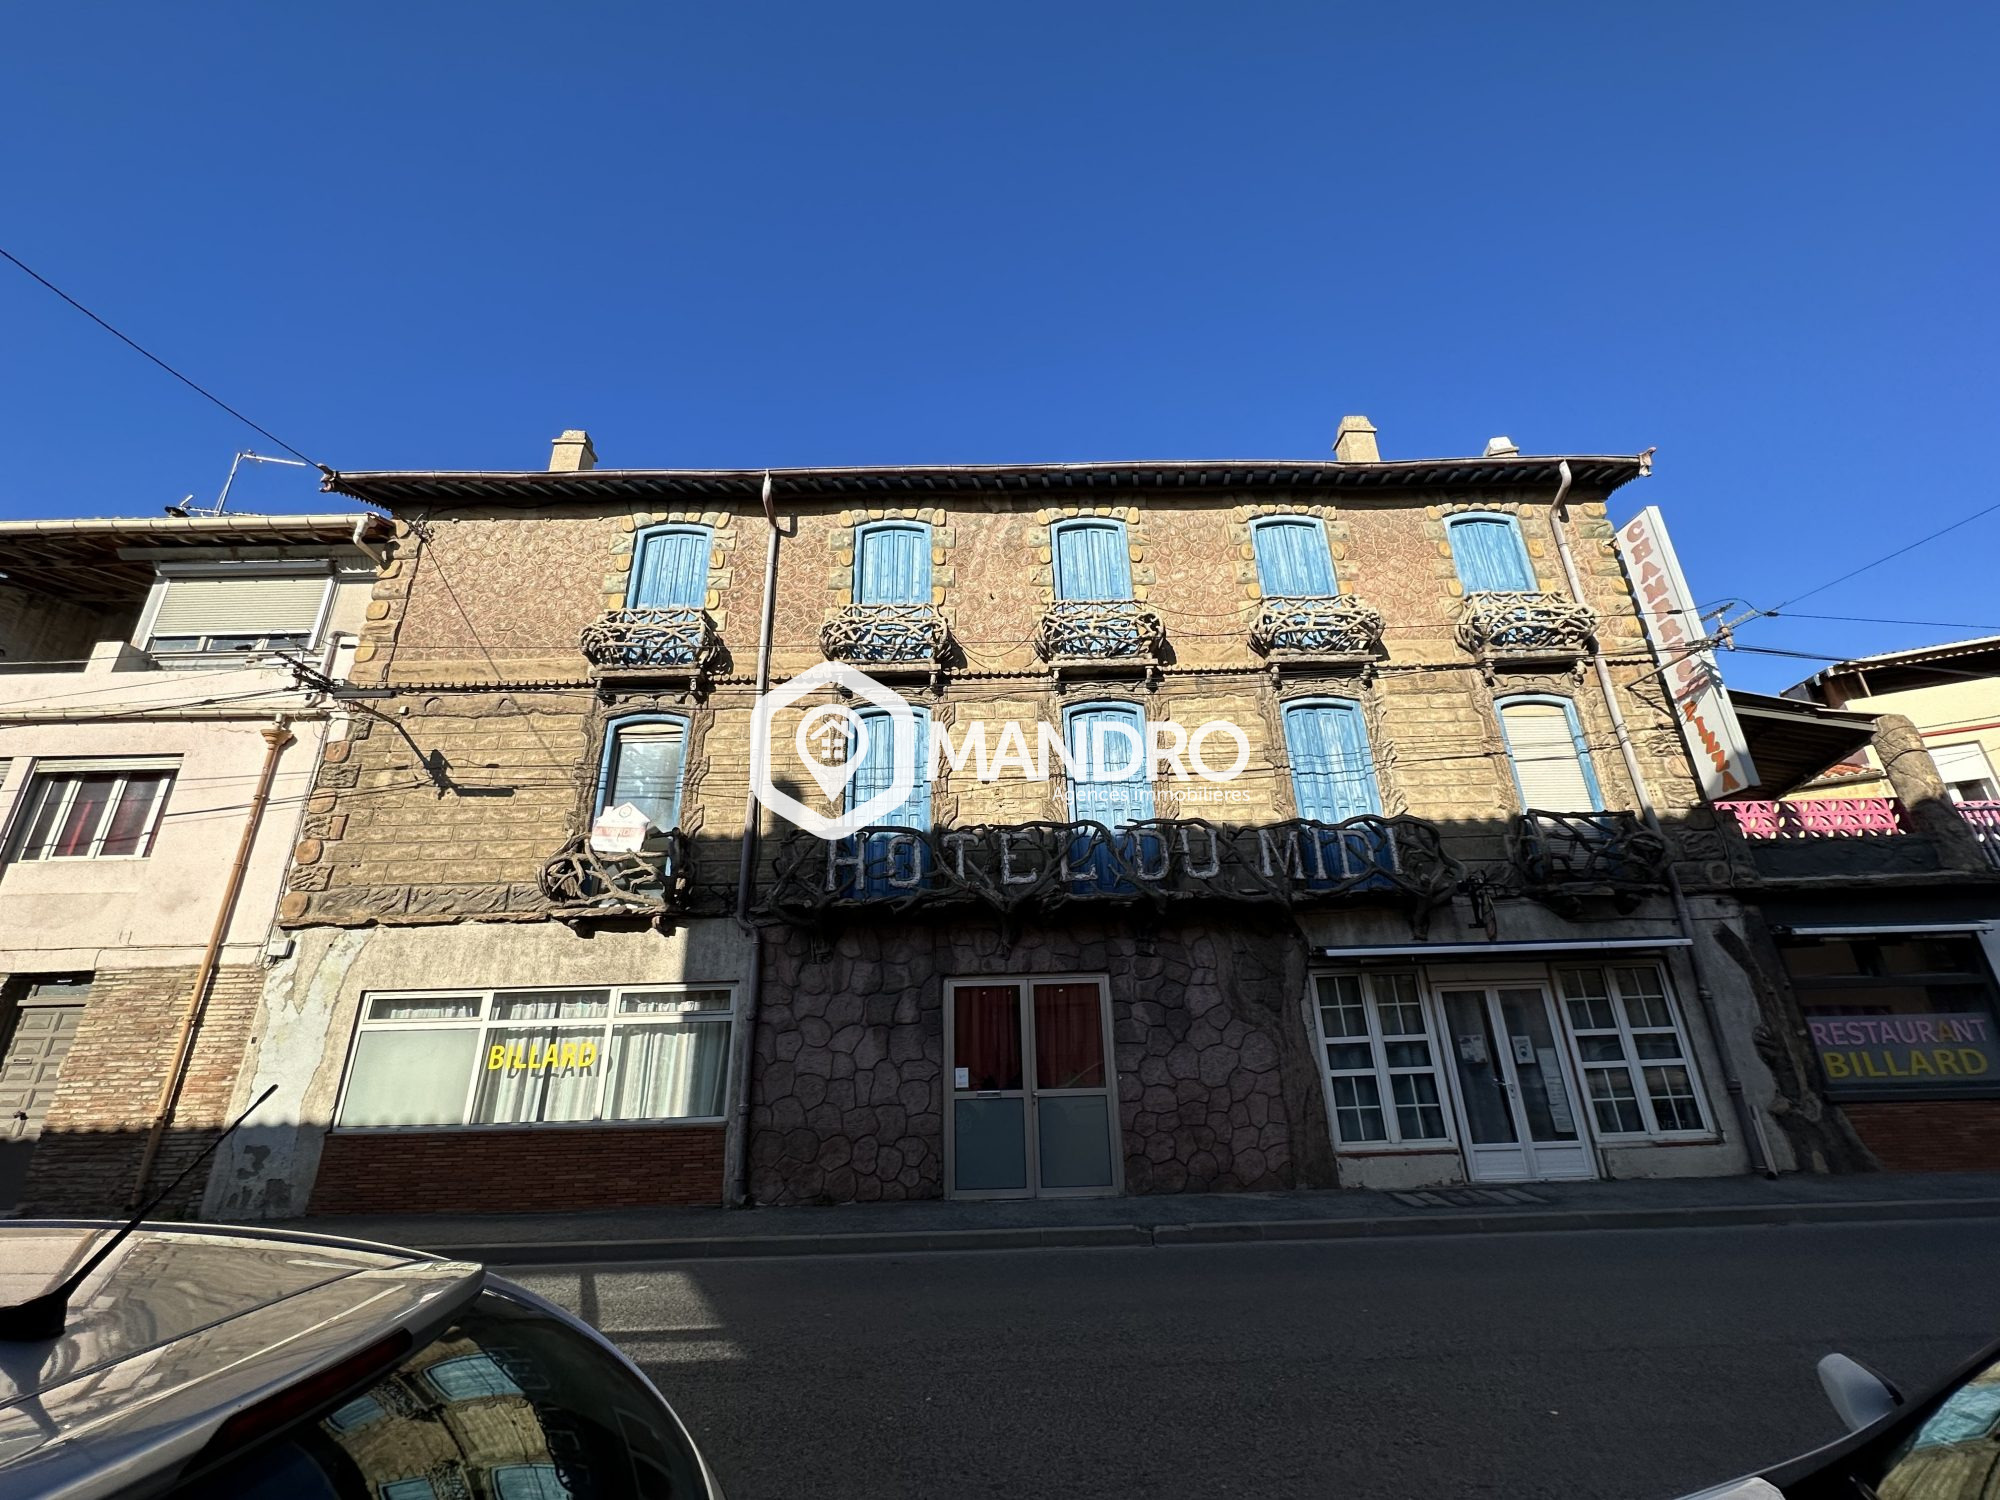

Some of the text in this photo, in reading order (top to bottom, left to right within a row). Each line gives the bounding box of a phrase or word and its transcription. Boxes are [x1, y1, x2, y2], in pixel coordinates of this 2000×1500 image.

[1682, 700, 1740, 792] PIZZA
[825, 827, 1403, 892] HOTEL DU MIDI
[1807, 1018, 1988, 1046] RESTAURANT
[487, 1041, 597, 1070] BILLARD
[1823, 1048, 1989, 1079] BILLARD
